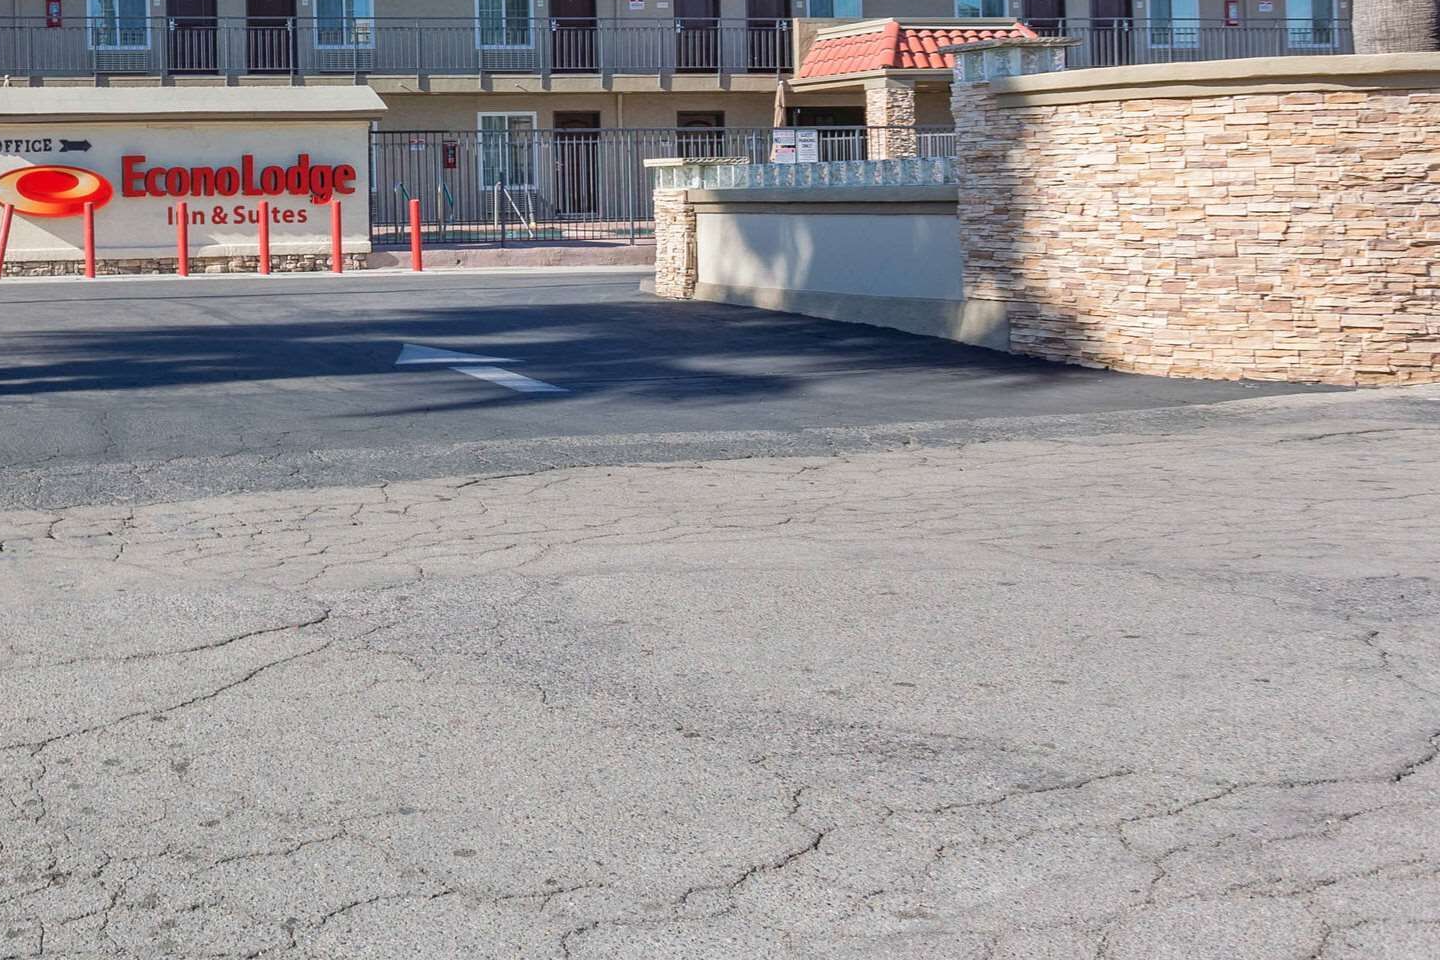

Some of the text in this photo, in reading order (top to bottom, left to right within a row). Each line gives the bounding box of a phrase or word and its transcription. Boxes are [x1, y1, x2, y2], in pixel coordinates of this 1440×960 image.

[122, 153, 356, 205] EconoLodge
[211, 205, 228, 224] &
[233, 205, 308, 224] Sutes
